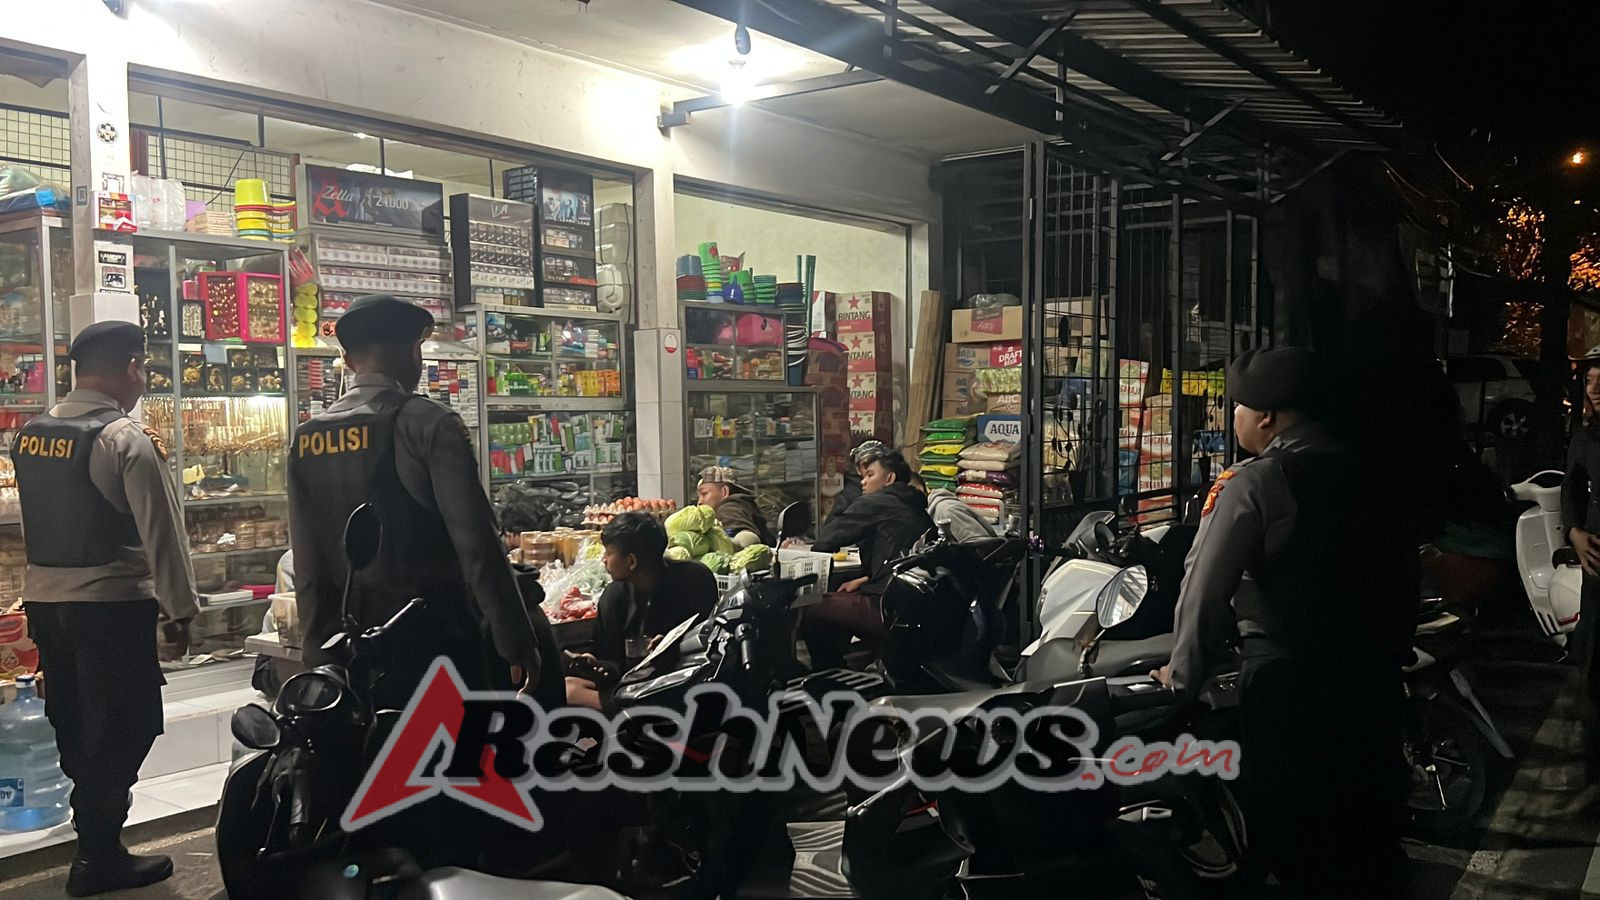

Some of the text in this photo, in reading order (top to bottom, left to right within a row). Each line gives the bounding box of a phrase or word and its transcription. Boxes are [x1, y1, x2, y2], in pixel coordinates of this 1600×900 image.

[838, 311, 871, 321] BINTANG
[848, 350, 873, 360] NTANG
[998, 349, 1023, 363] DRAFT
[850, 429, 873, 437] TANG
[990, 424, 1020, 436] AQUA
[18, 435, 74, 458] POLISI
[299, 425, 368, 458] POLISI
